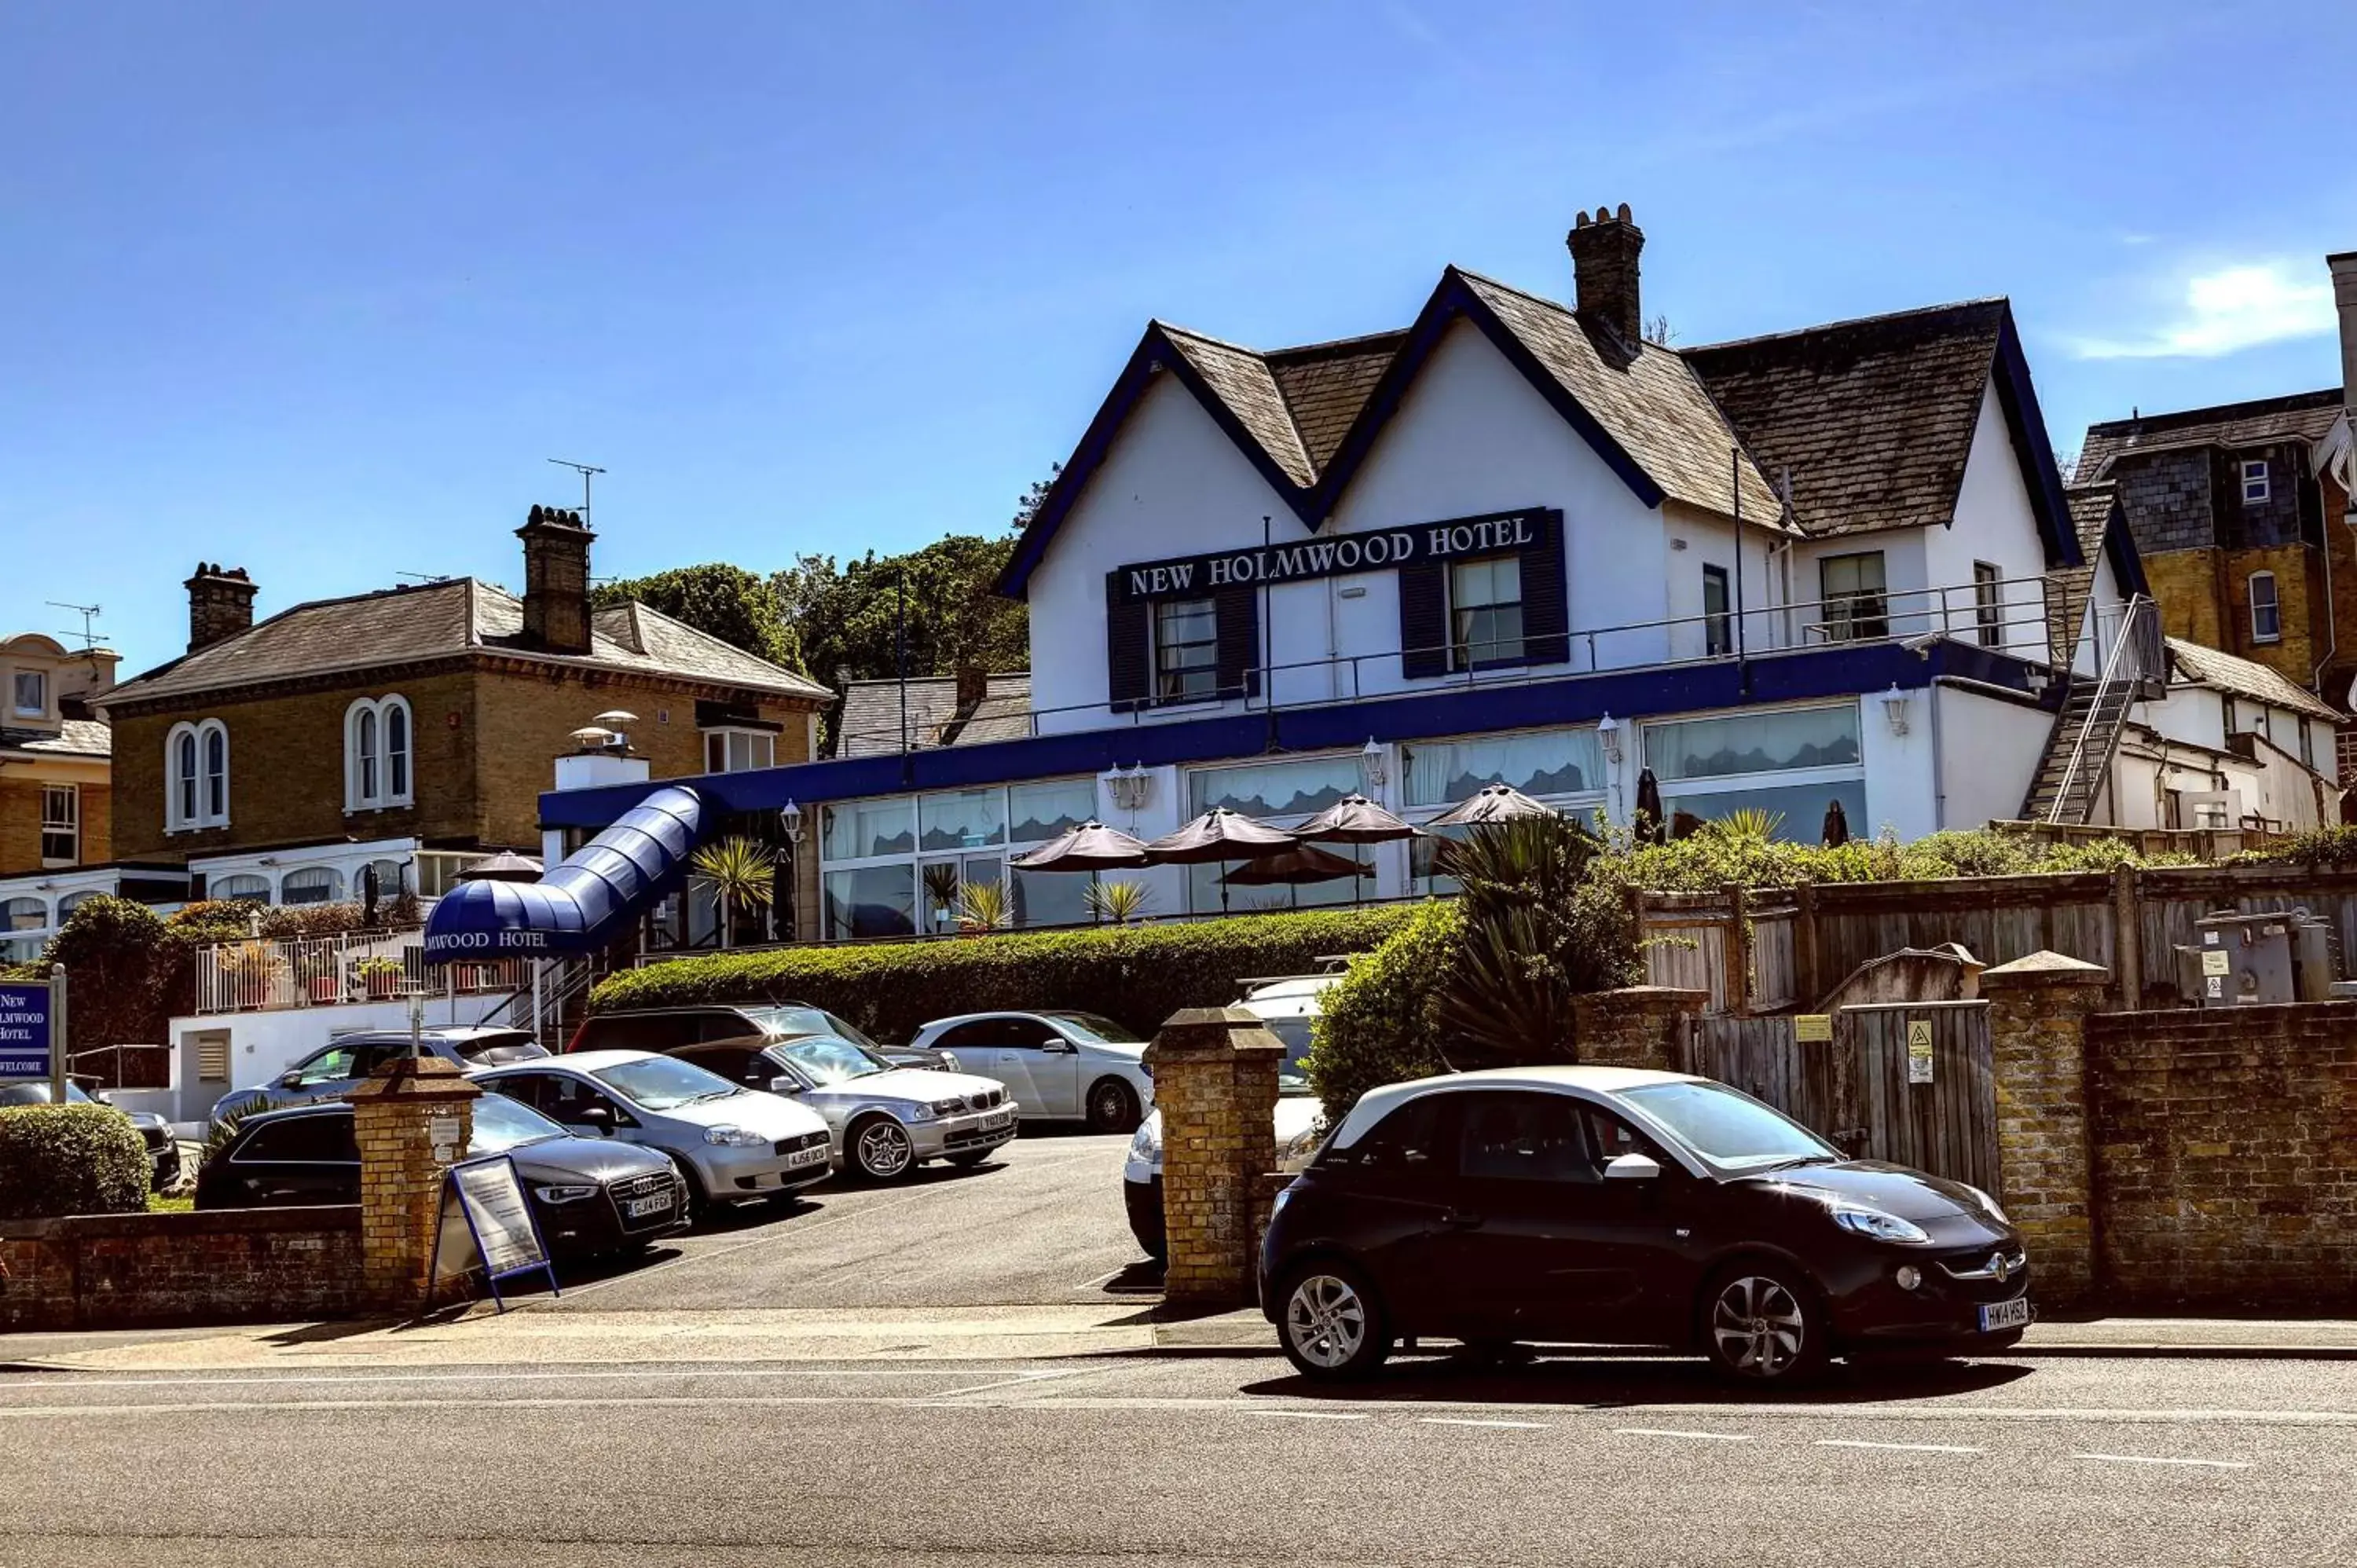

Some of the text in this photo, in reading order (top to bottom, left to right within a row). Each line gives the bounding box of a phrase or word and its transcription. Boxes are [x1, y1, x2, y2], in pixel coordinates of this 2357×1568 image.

[1131, 518, 1532, 595] NEW HOLMWOOD HOTEL
[498, 932, 547, 947] HOTEL
